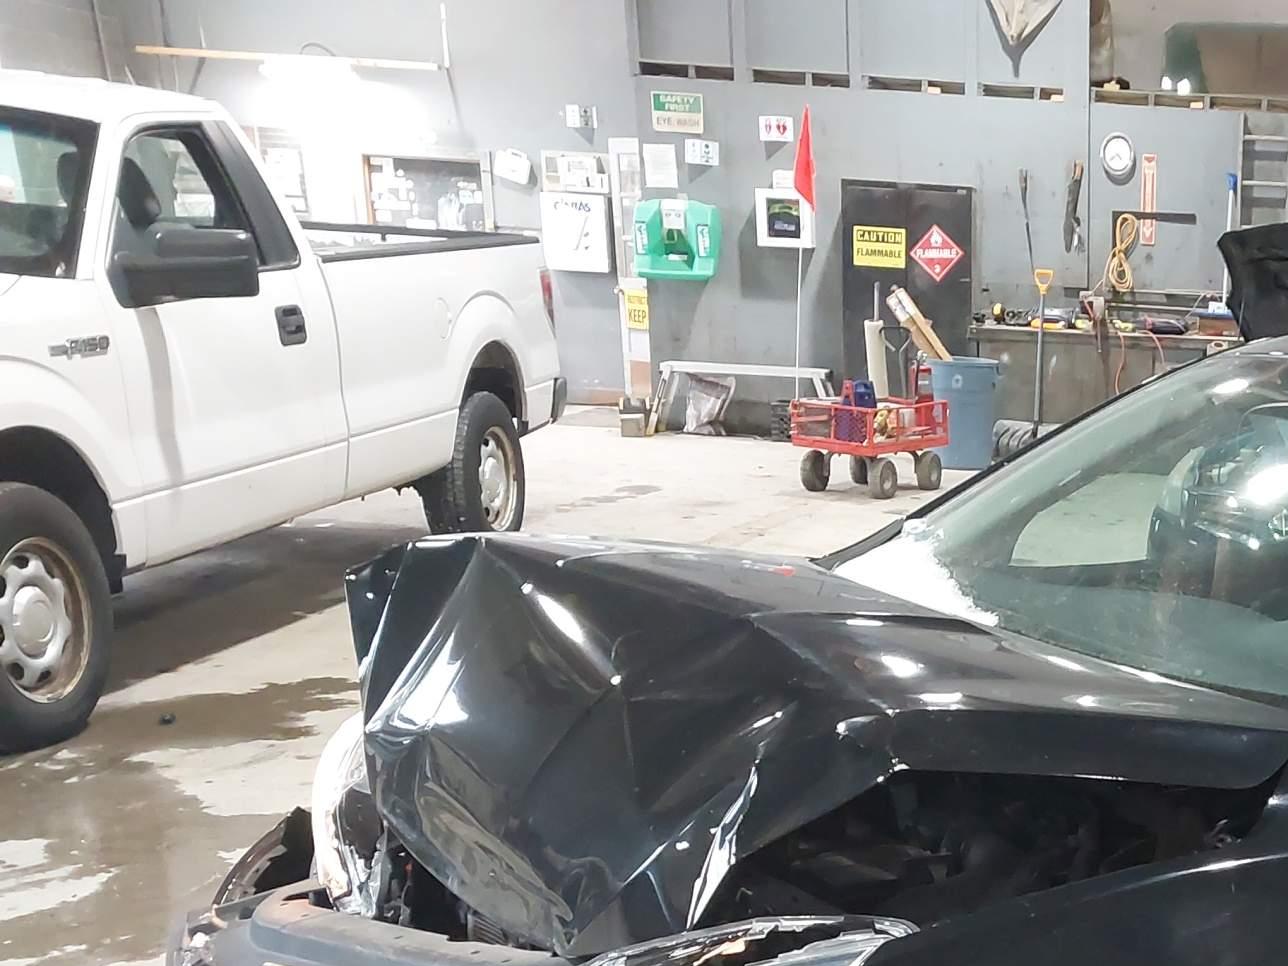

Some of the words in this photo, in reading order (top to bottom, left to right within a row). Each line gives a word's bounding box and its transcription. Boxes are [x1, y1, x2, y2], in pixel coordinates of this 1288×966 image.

[856, 231, 903, 243] CAUTION
[856, 248, 902, 258] FLAMMABLE
[628, 308, 647, 323] KEEP
